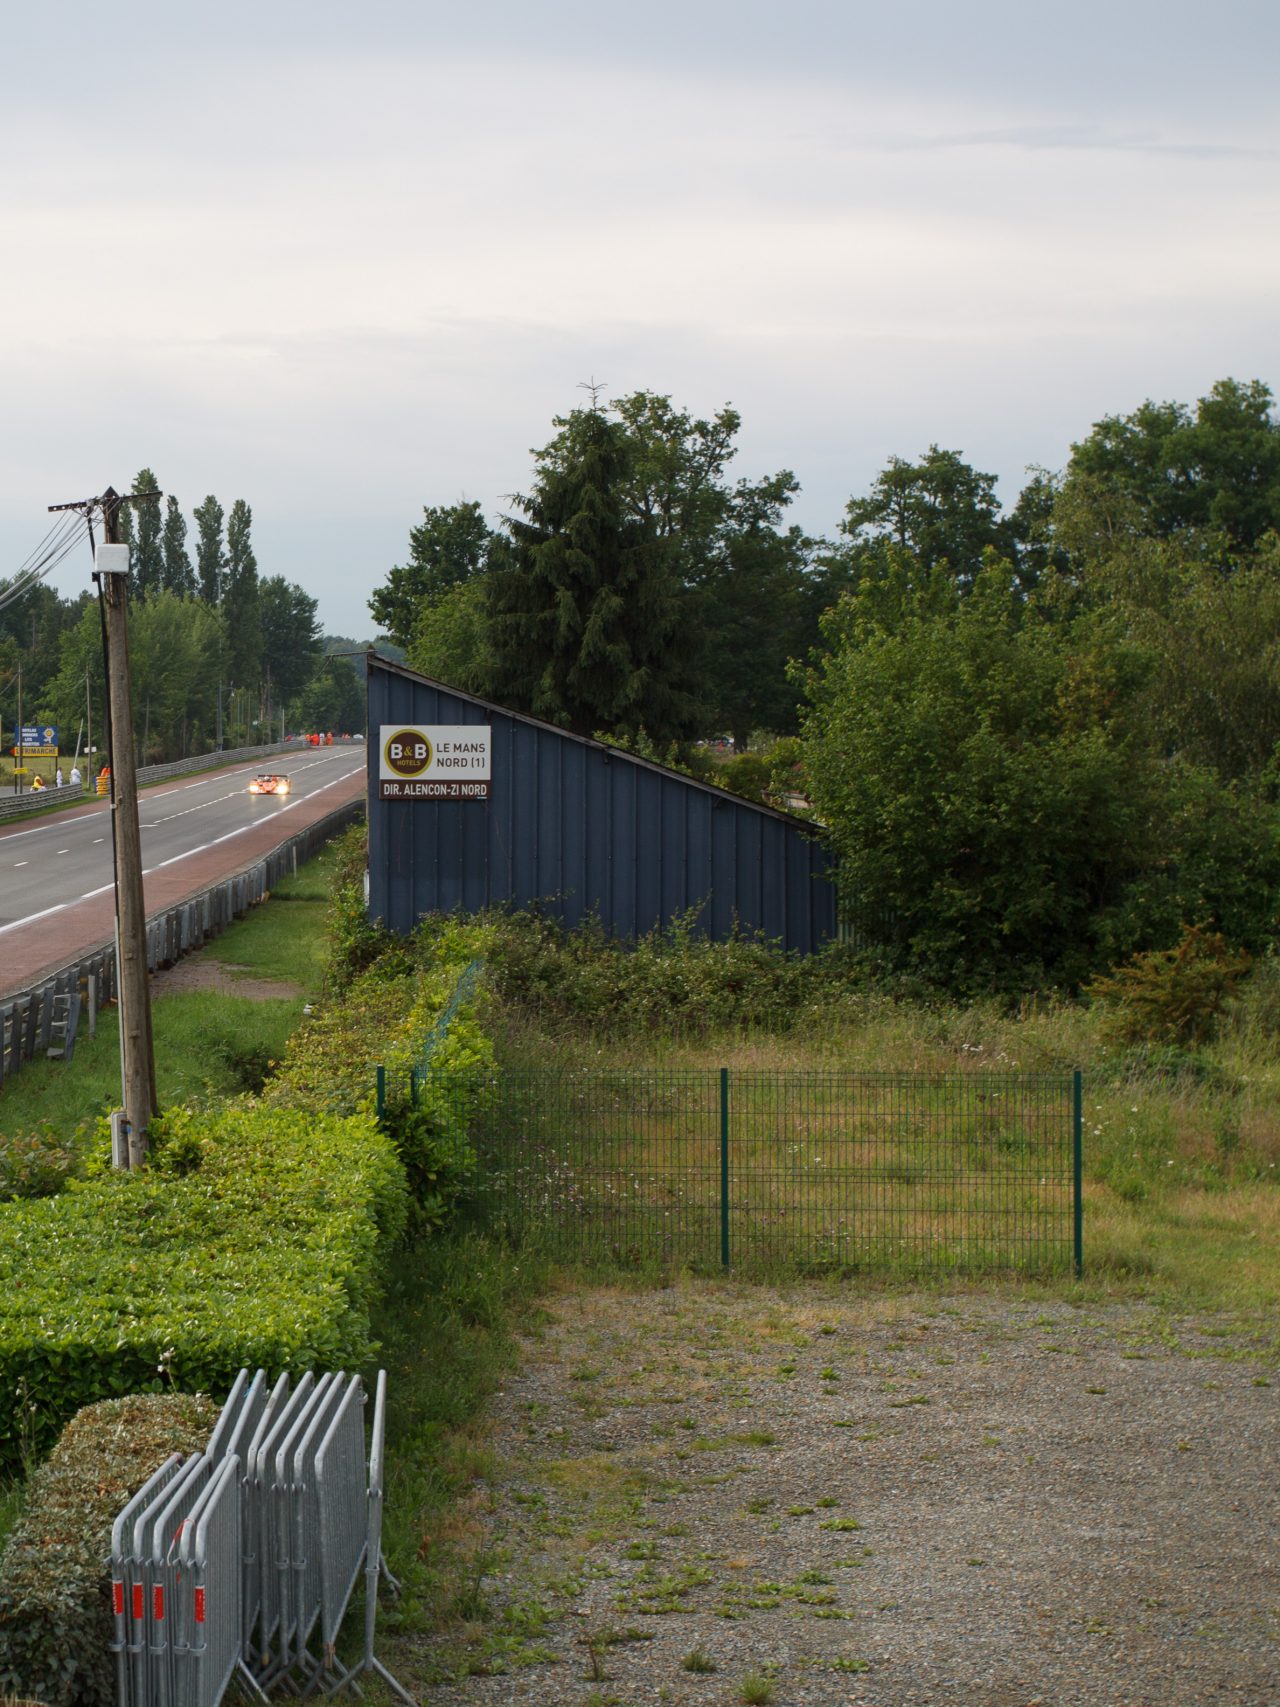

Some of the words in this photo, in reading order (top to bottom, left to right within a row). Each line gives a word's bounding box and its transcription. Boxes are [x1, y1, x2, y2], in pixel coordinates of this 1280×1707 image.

[436, 743, 450, 753] LE
[453, 743, 486, 753] MANS
[436, 757, 468, 768] NORD
[471, 757, 485, 768] (1)
[383, 783, 402, 795] DIR.
[404, 783, 459, 796] ALENCON-ZI
[461, 784, 487, 796] NORD
